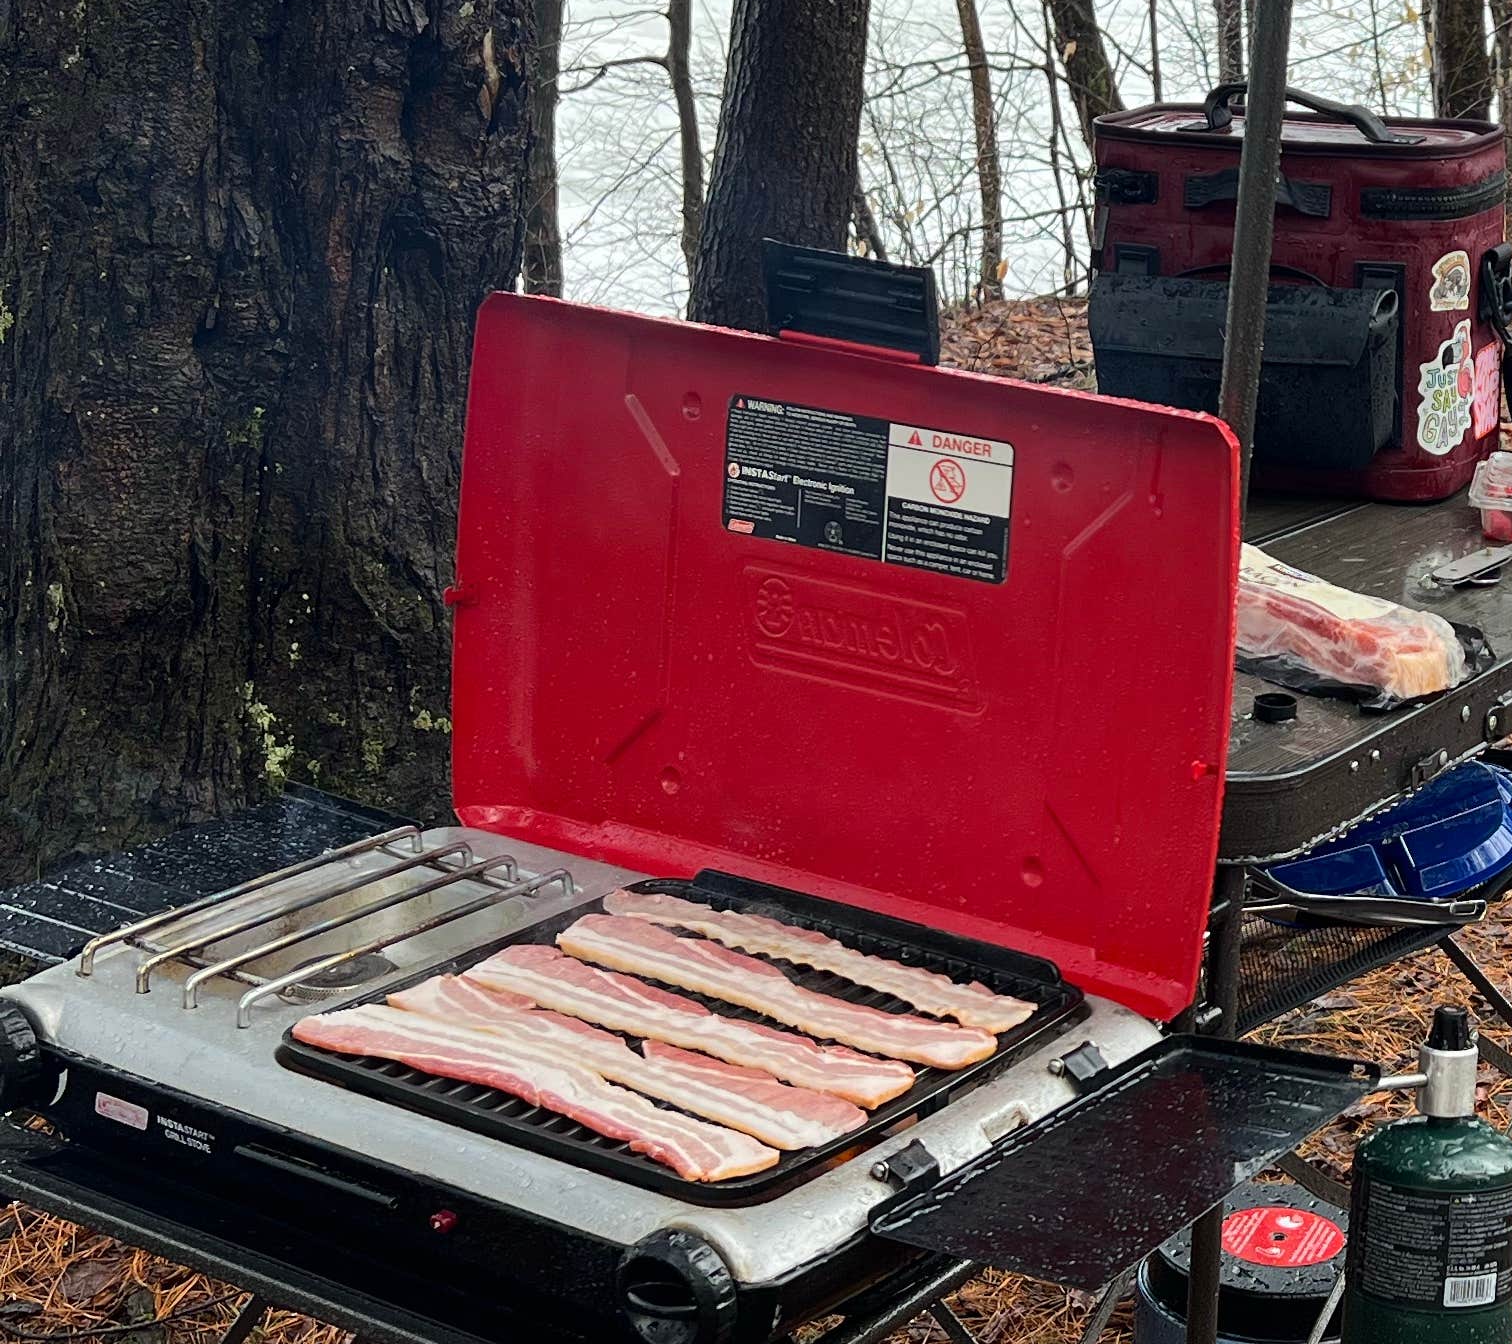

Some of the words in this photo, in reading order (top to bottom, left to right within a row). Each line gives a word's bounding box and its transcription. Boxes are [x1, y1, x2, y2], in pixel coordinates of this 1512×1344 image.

[1426, 367, 1458, 389] JUST
[1432, 385, 1457, 413] SAY
[1422, 407, 1458, 448] GAY
[932, 435, 992, 457] DANGER
[792, 475, 827, 490] Electronic
